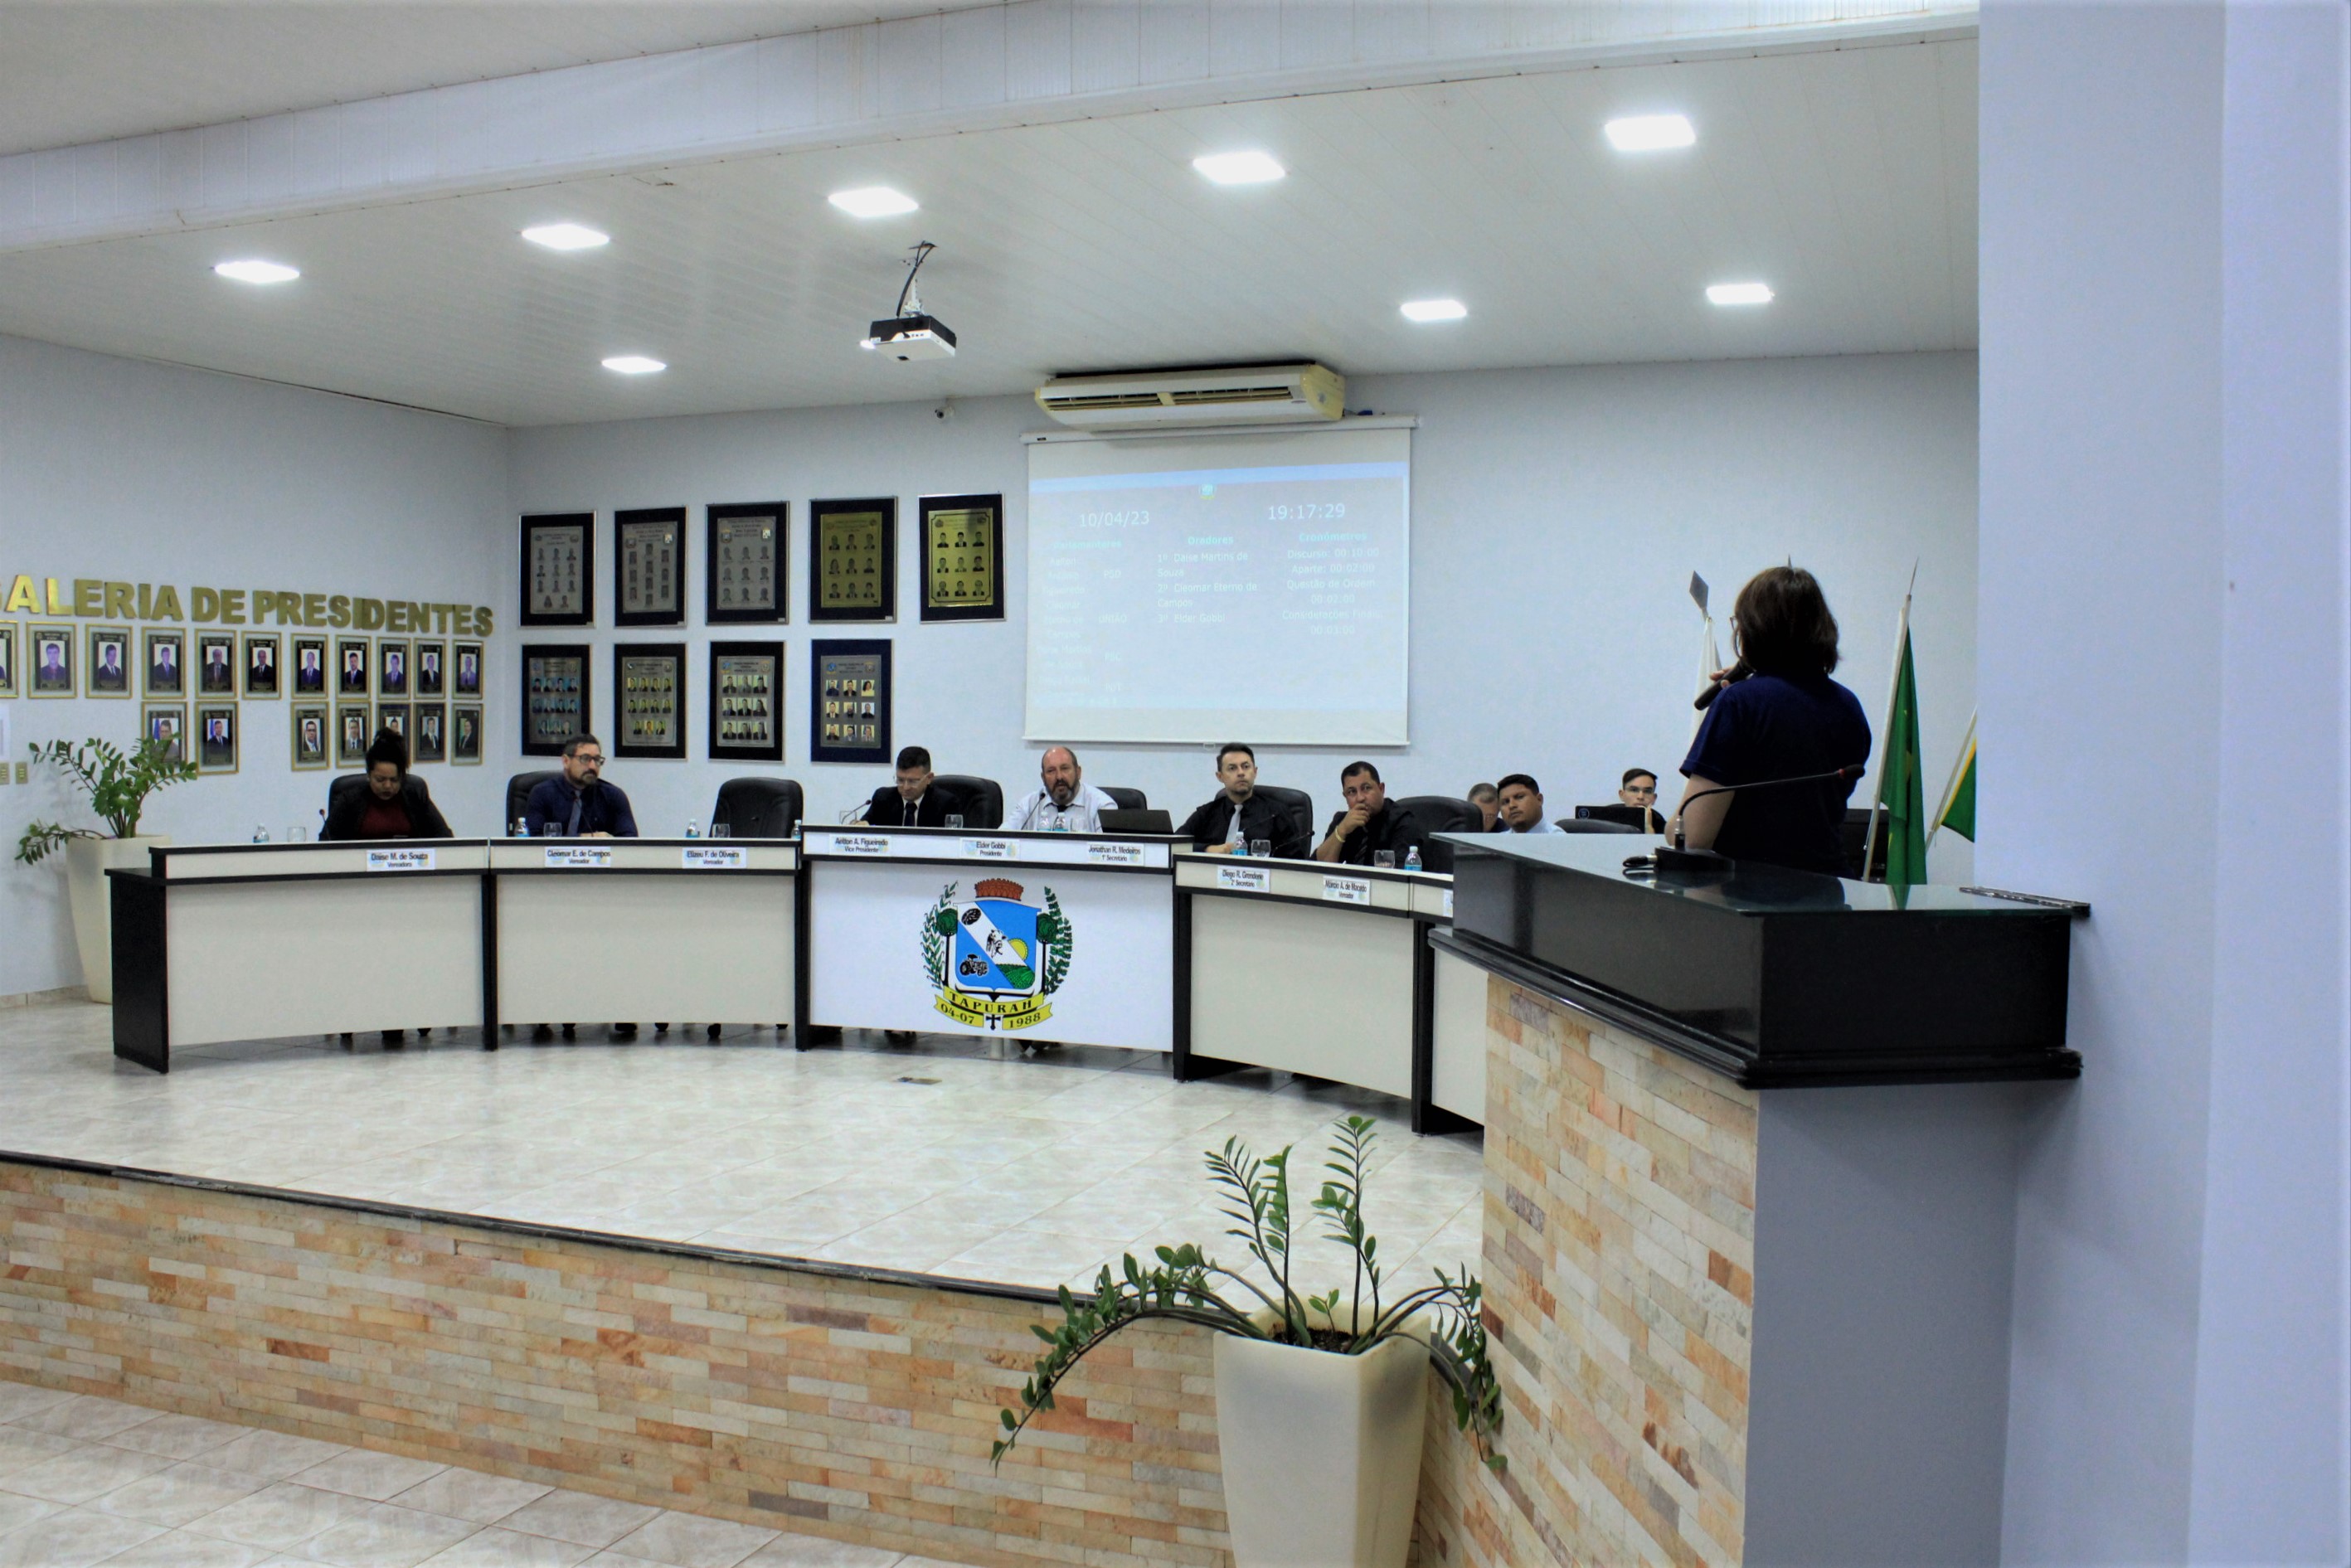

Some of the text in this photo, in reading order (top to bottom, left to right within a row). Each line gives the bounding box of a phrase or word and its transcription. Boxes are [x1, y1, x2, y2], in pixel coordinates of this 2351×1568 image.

[1268, 502, 1345, 521] 19:17:29
[1079, 510, 1150, 529] 10/04/23
[1188, 535, 1234, 545] Oradores
[1173, 553, 1199, 563] Daise
[1201, 551, 1234, 562] Martins
[1237, 551, 1248, 561] de
[1104, 569, 1121, 579] PSD
[1158, 568, 1184, 577] Souza
[1174, 583, 1211, 593] Cleomar
[1246, 581, 1257, 591] de
[1329, 580, 1339, 588] de
[0, 574, 494, 638] ALERIA DE PRESIDENTES
[1158, 599, 1194, 609] Campos
[1174, 613, 1197, 623] Elder
[1199, 612, 1226, 623] Gobbi
[861, 837, 888, 847] Figueiredo
[991, 841, 1006, 849] Gobbi
[587, 850, 611, 858] Campos
[1088, 845, 1111, 853] Jonathan
[1119, 847, 1141, 855] Medeiros
[371, 852, 388, 861] Daise
[1222, 869, 1236, 880] Diego
[1236, 870, 1241, 878] R.
[1345, 882, 1351, 891] de
[949, 991, 1032, 1013] TAPURAH
[940, 1002, 975, 1025] 04-07
[1008, 1012, 1042, 1029] 1988
